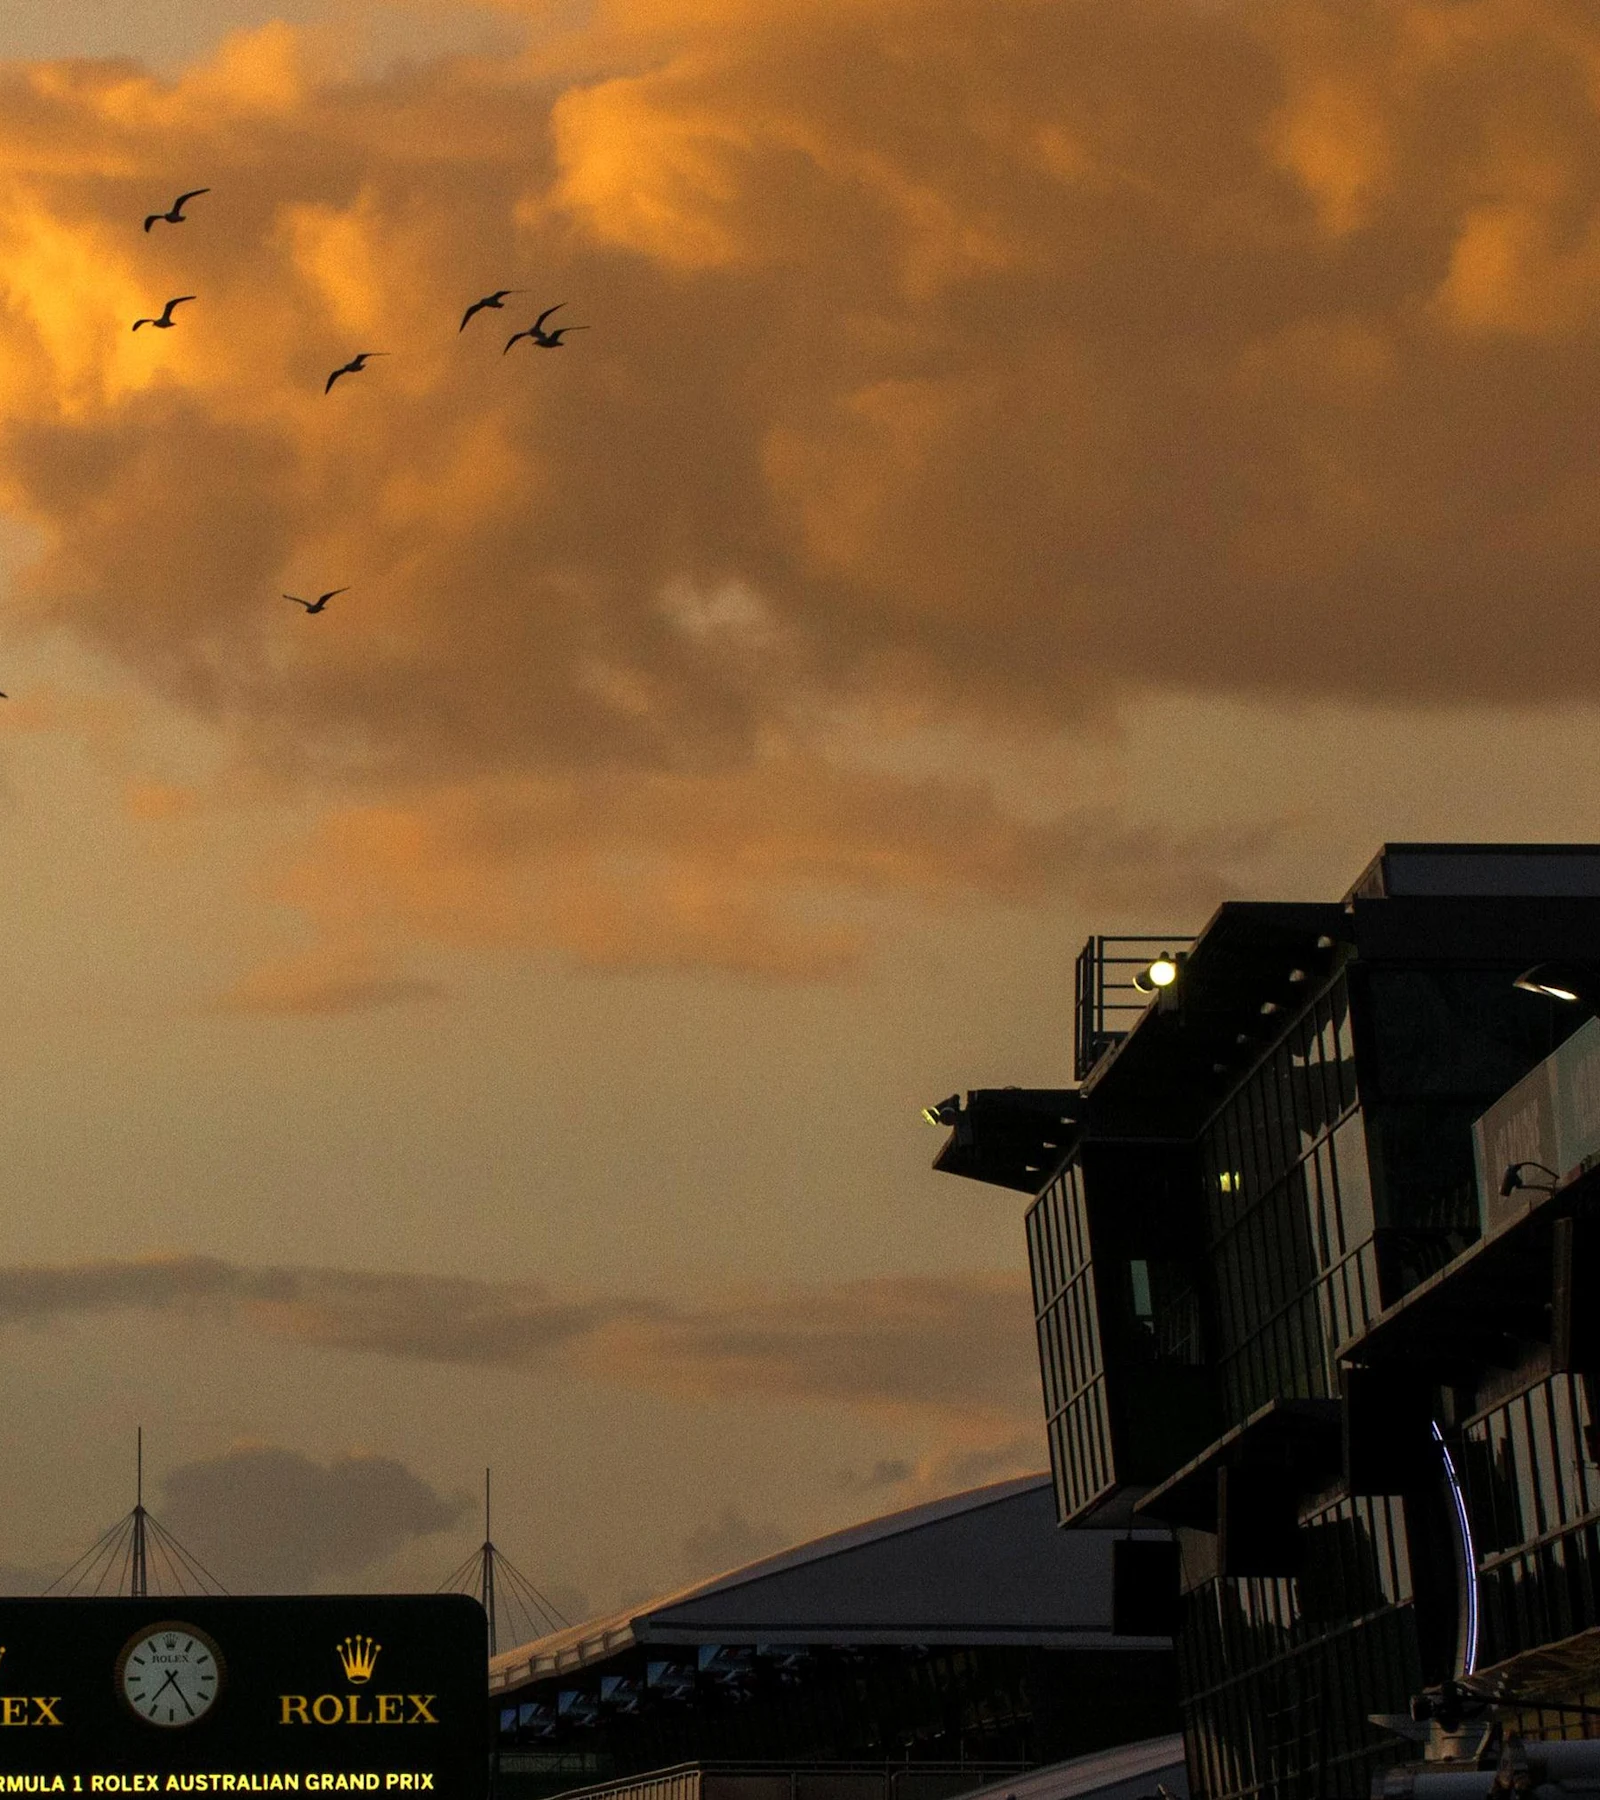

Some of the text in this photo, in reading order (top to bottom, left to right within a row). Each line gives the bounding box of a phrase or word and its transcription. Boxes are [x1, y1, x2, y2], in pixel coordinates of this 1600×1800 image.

[152, 1655, 189, 1663] ROLEX
[280, 1695, 438, 1724] ROLEX
[73, 1775, 83, 1792] 1
[91, 1775, 159, 1792] ROLEX
[166, 1774, 298, 1791] AUSTRALIAN
[305, 1774, 379, 1791] GRAND
[386, 1774, 434, 1790] PRIX
